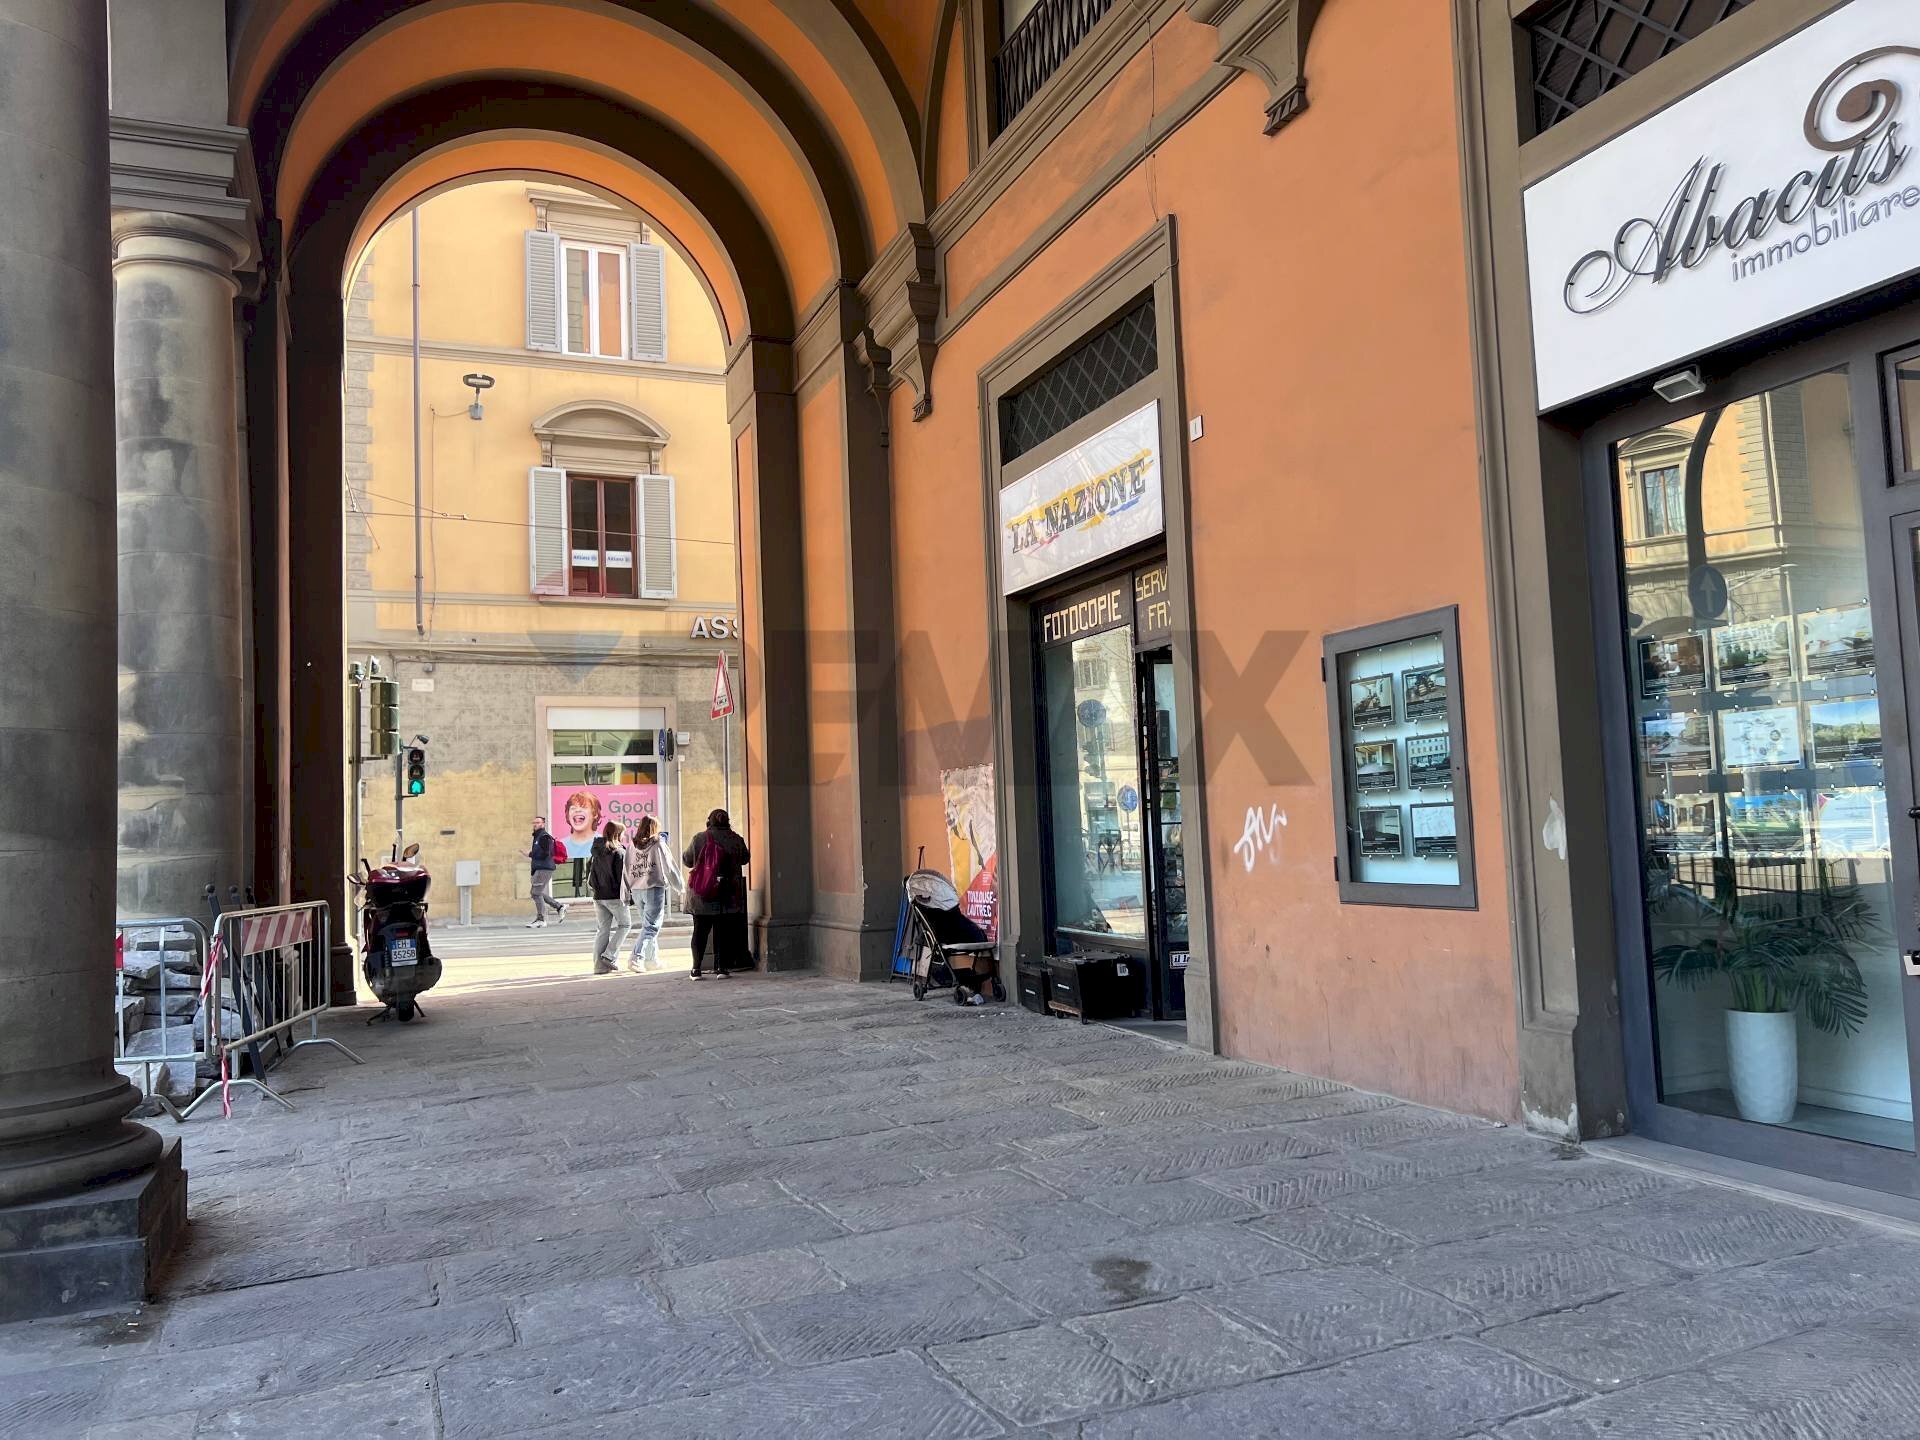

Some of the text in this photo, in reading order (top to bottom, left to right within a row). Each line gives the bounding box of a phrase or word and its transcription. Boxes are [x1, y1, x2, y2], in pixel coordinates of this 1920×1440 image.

[1563, 121, 1911, 315] Abacus
[1731, 185, 1920, 283] immobiliare
[1012, 457, 1147, 554] LA NAZIONE
[1135, 566, 1168, 602] SERV
[1043, 589, 1122, 643] FOTOCOPIE
[608, 800, 654, 813] Good
[967, 904, 992, 918] LAUTREC
